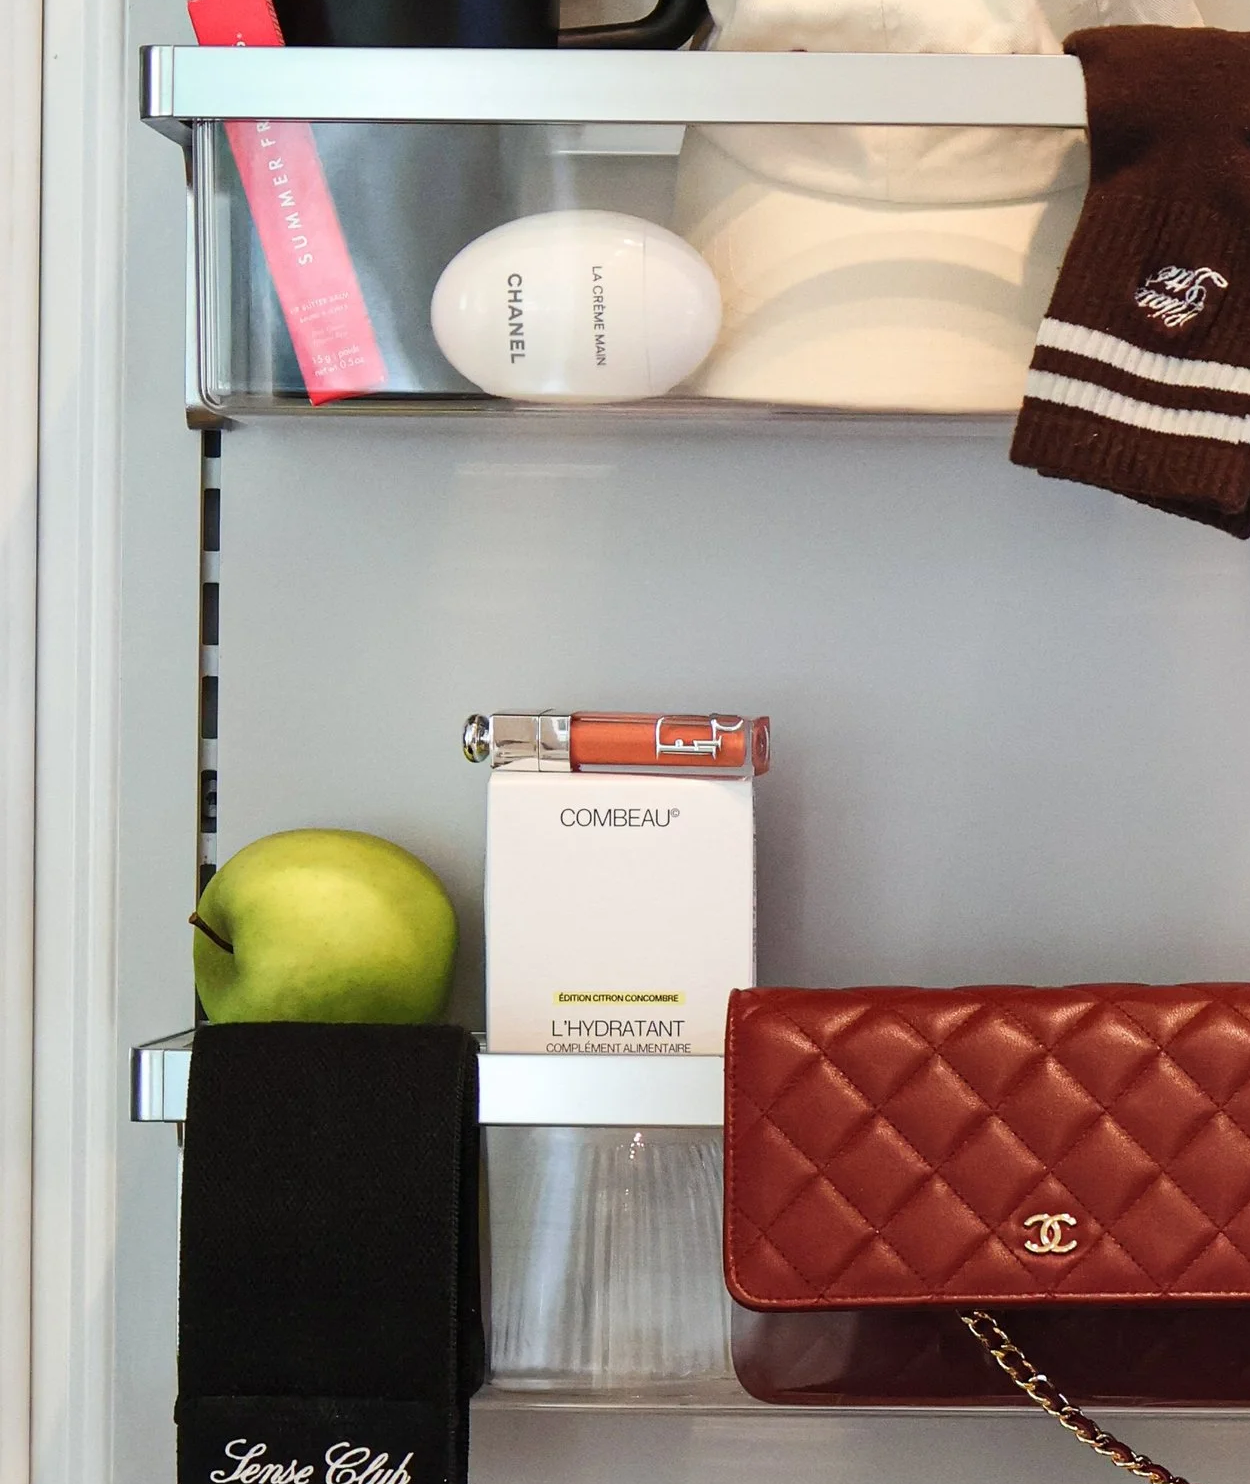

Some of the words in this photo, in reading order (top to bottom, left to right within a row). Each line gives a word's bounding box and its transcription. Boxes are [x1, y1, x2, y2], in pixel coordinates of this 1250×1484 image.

[268, 157, 314, 266] SUMMER
[592, 265, 603, 282] LA
[507, 273, 526, 364] CHANEL
[592, 285, 607, 331] CRÈME
[594, 334, 607, 366] MAIN
[558, 992, 592, 1002] ÉDITION
[592, 994, 624, 1002] CITRON
[625, 994, 679, 1002] CONCOMBRE
[551, 1020, 686, 1037] L'HYDRATANT
[546, 1041, 621, 1053] COMPLÉMENT
[623, 1043, 692, 1053] ALIMENTAIRE
